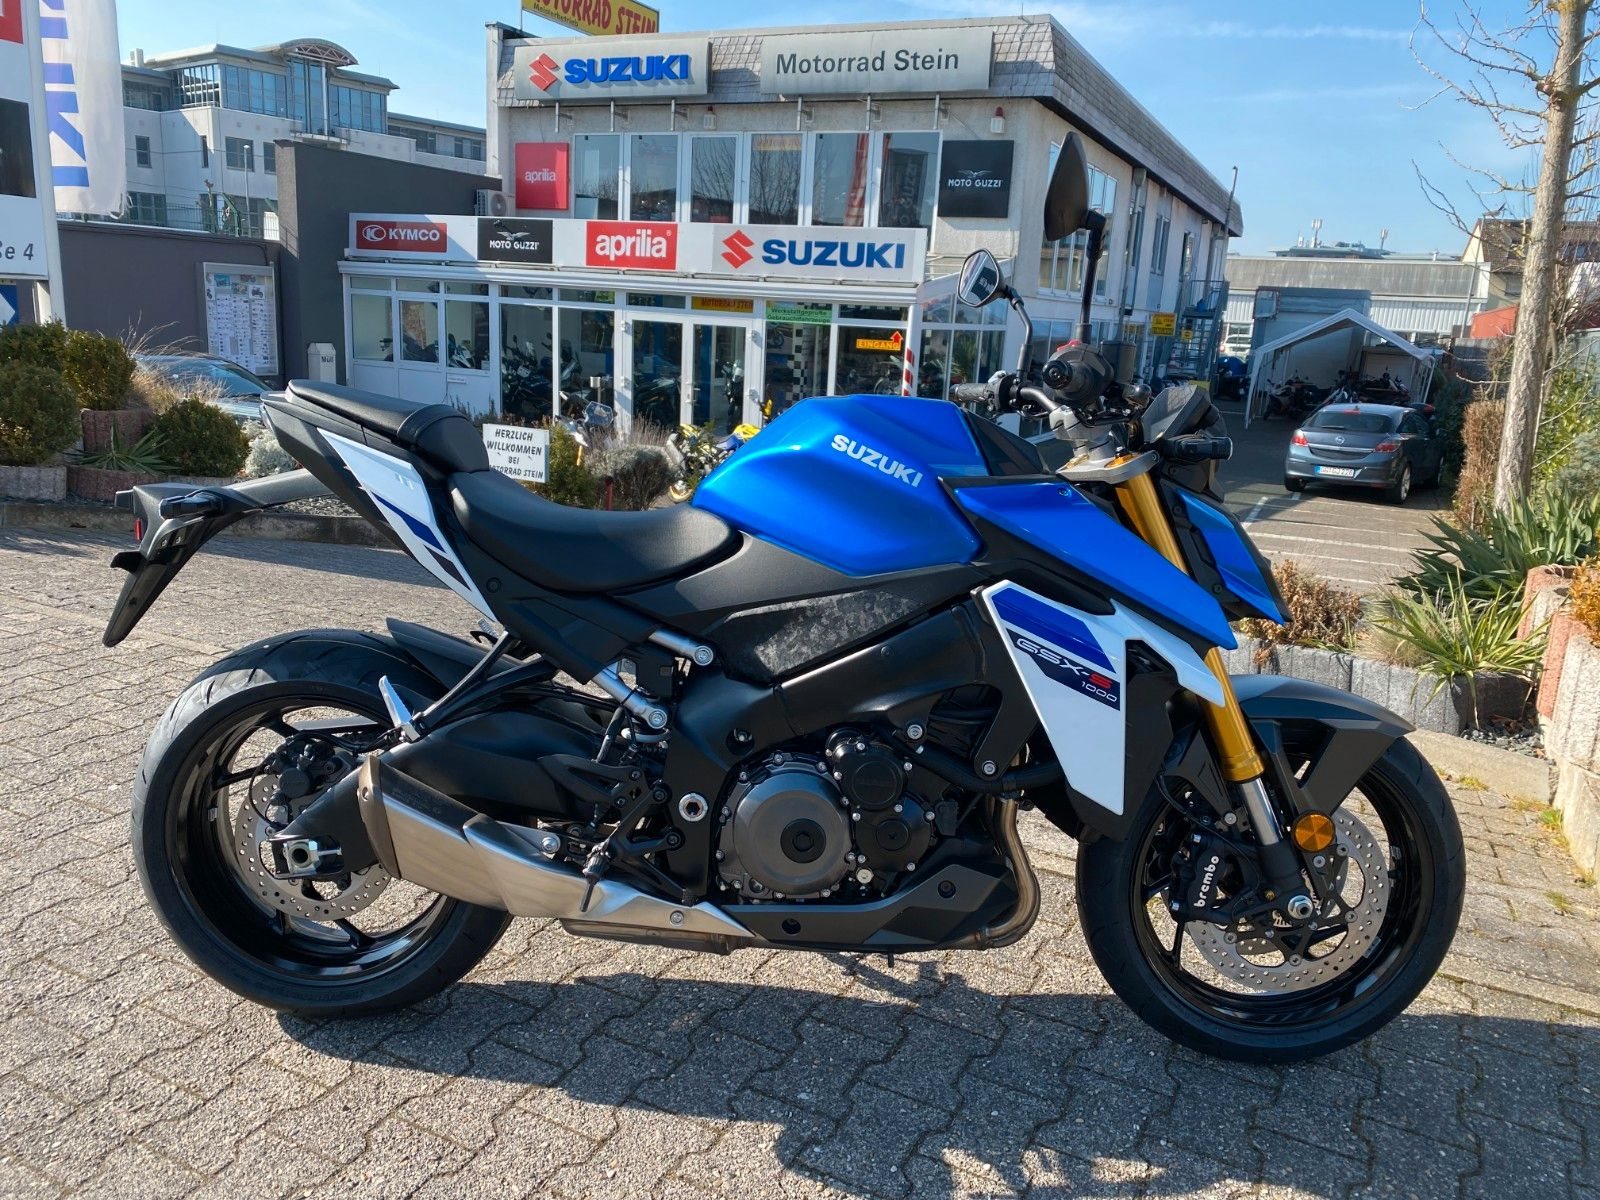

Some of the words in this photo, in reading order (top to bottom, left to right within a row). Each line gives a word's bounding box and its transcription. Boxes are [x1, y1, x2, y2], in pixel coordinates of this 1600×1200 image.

[564, 54, 689, 84] SUZUKI
[776, 50, 885, 74] Motorrad
[894, 48, 959, 71] Stein
[525, 168, 556, 183] aprilia
[948, 179, 972, 187] MOTO
[974, 179, 1002, 188] GUZZI
[388, 228, 440, 241] KYMCO
[23, 243, 34, 260] 4
[489, 239, 511, 249] MOTO
[514, 241, 539, 250] GUZZI
[595, 229, 667, 261] aprilia
[762, 239, 905, 269] SUZUKI
[858, 340, 900, 349] EINGANG
[495, 428, 533, 441] HERZLICH
[486, 440, 542, 456] WILLKOMMEN
[508, 456, 520, 465] BEI
[831, 434, 923, 488] SUZUKI
[524, 469, 544, 479] STEIN
[1016, 638, 1112, 689] GSX-S
[1082, 681, 1118, 703] 1000
[1193, 855, 1220, 908] brembo
